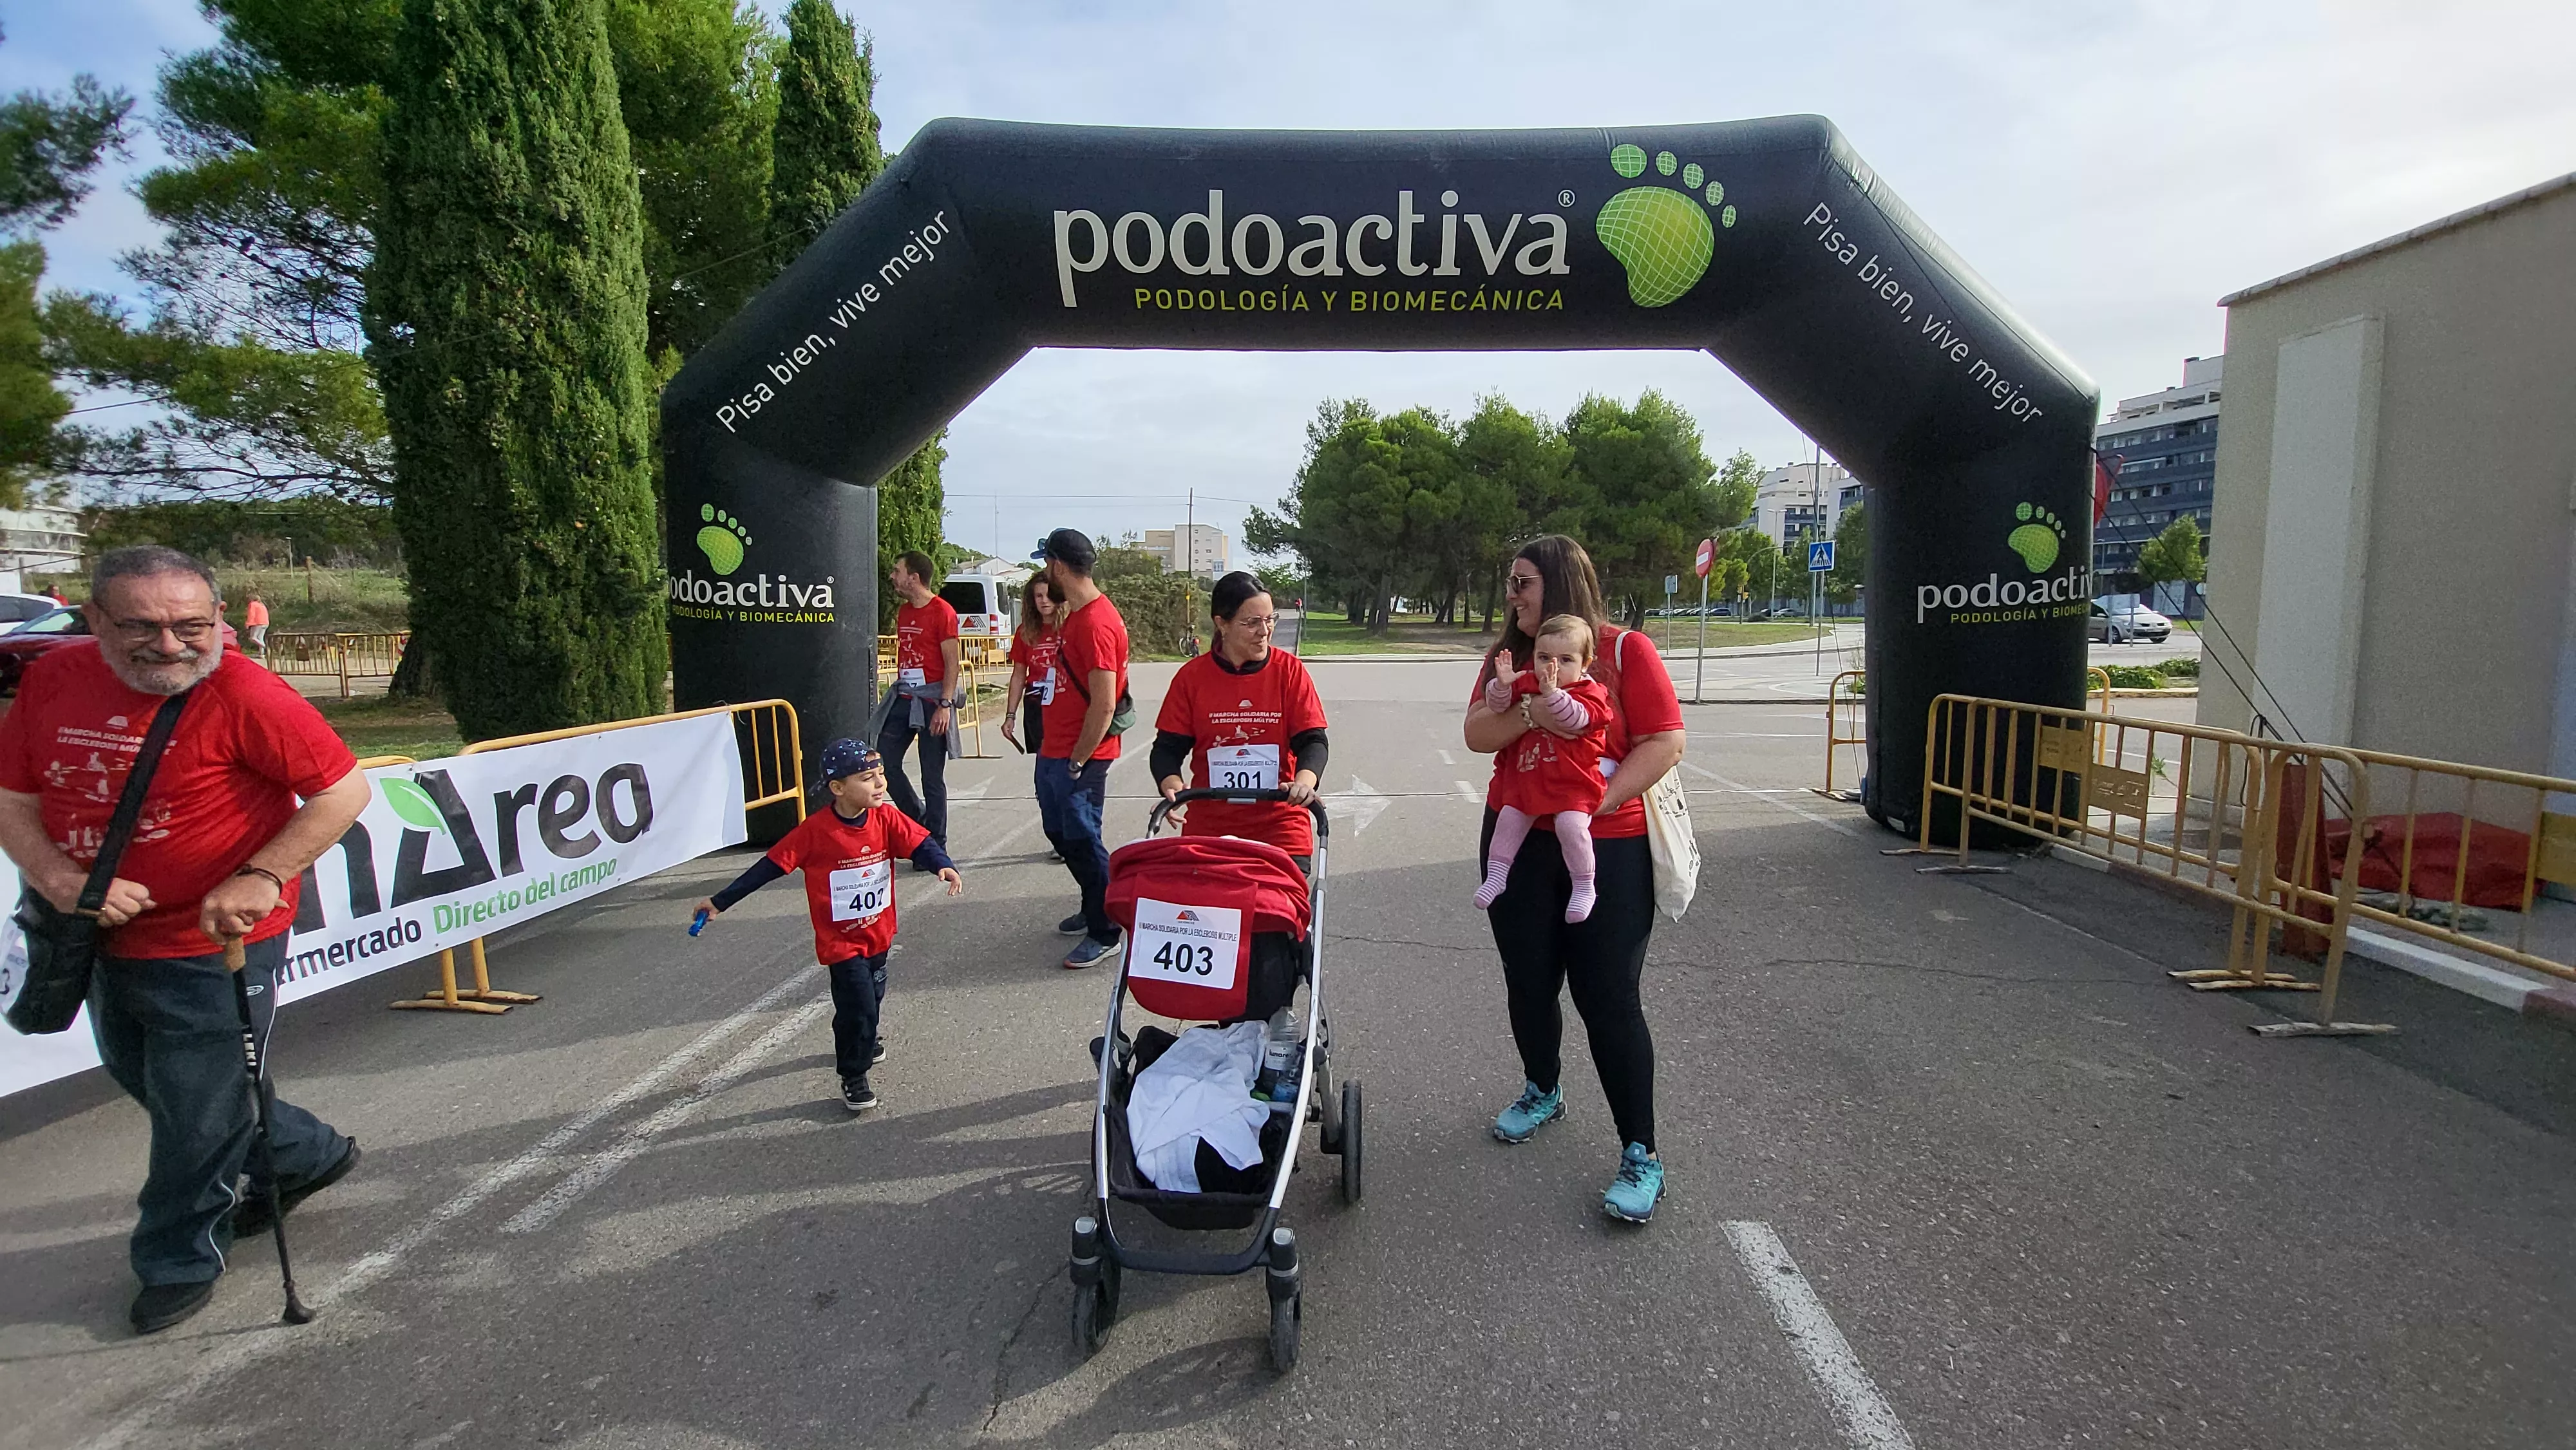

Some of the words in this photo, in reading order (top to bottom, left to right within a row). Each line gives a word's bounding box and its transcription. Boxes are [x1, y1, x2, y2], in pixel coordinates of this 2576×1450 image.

[1135, 283, 1309, 312] PODOLOGÍA
[1321, 290, 1338, 312] Y
[1350, 283, 1564, 312] BIOMECÁNICA
[1803, 202, 1859, 266] Pisa
[1857, 254, 1914, 323] bien,
[1921, 314, 1970, 363] vive
[1967, 358, 2043, 422] mejor
[715, 382, 775, 433] Pisa
[766, 334, 836, 386] bien,
[829, 283, 880, 328] vive
[878, 211, 949, 286] mejor
[1917, 565, 2093, 624] podoactiv
[727, 611, 734, 621] Y
[740, 610, 835, 623] BIOMECÁNICA
[1950, 606, 2037, 624] PODOLOGÍA
[2041, 608, 2048, 619] Y
[1224, 771, 1261, 789] 301
[433, 889, 521, 934] Directo
[525, 872, 556, 905] del
[560, 858, 618, 894] campo
[1142, 922, 1159, 931] MARCHA
[1159, 924, 1179, 934] SOLIDARIA
[1153, 941, 1214, 976] 403
[242, 1033, 257, 1066] LEKI
